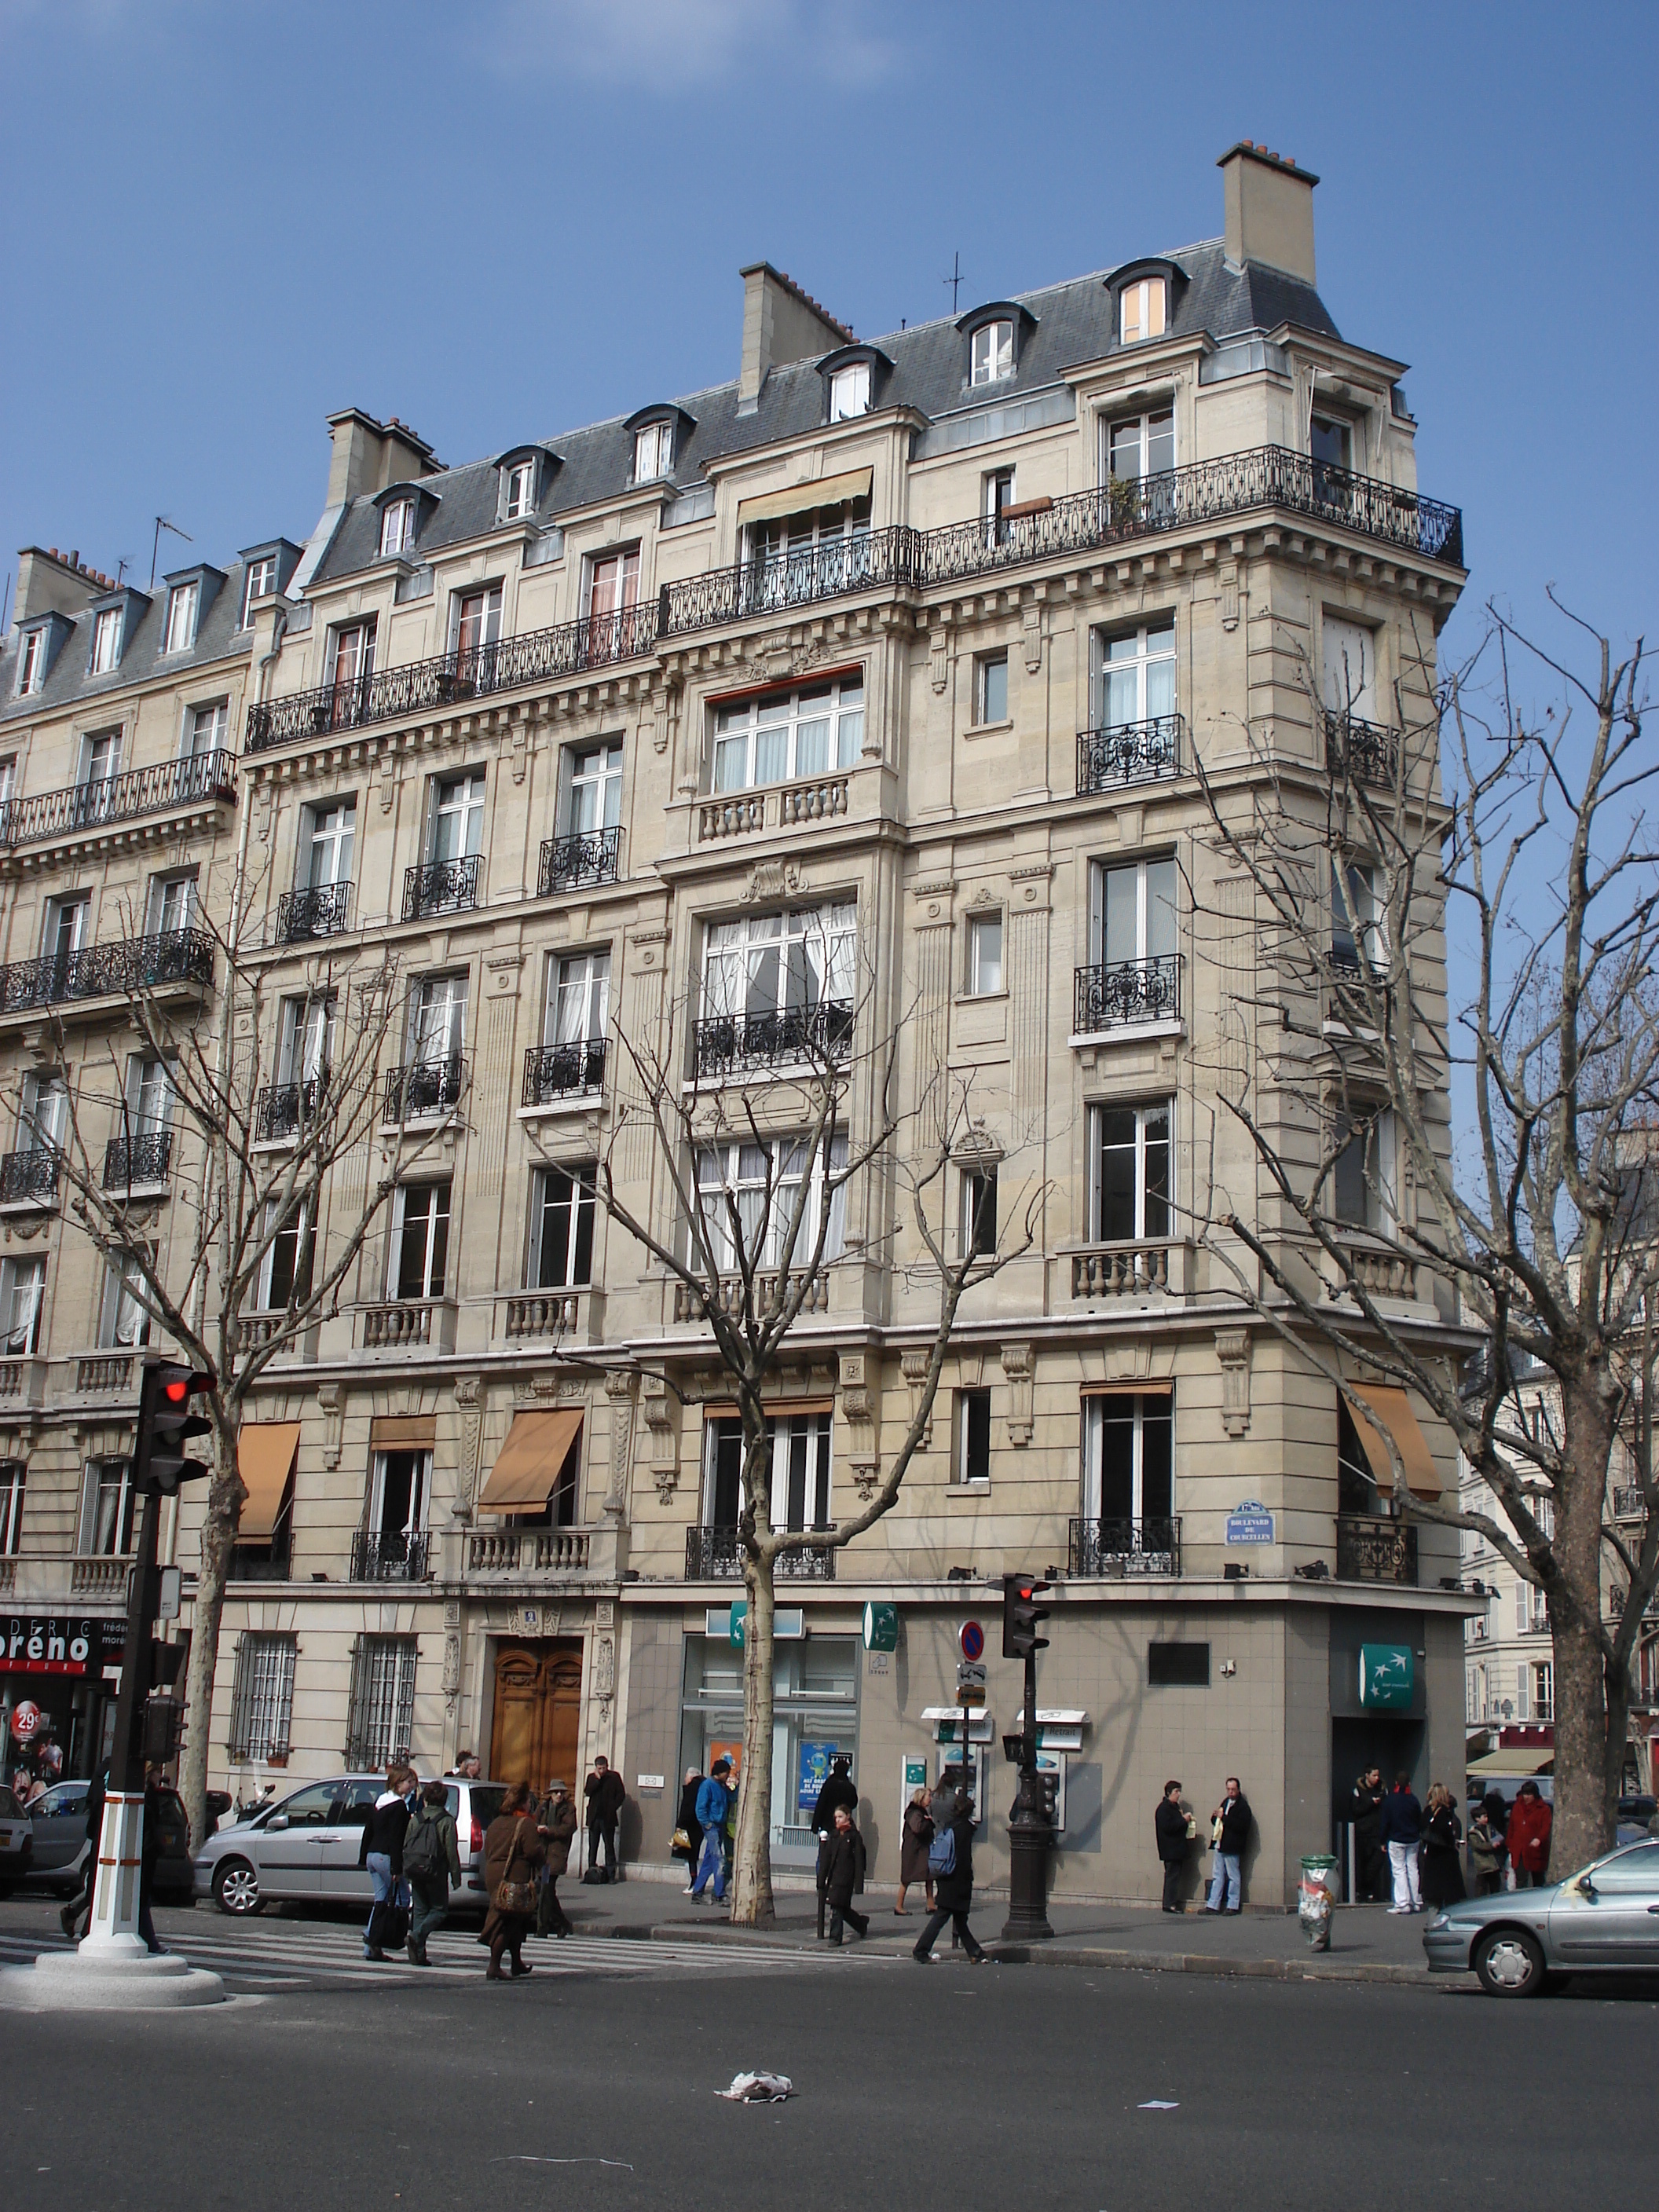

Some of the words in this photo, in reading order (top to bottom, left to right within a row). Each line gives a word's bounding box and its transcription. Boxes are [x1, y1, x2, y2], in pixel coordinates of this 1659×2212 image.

[528, 1612, 533, 1621] 2
[102, 1635, 126, 1645] moré
[961, 1720, 986, 1729] Rtrait
[1049, 1727, 1076, 1737] Retrait
